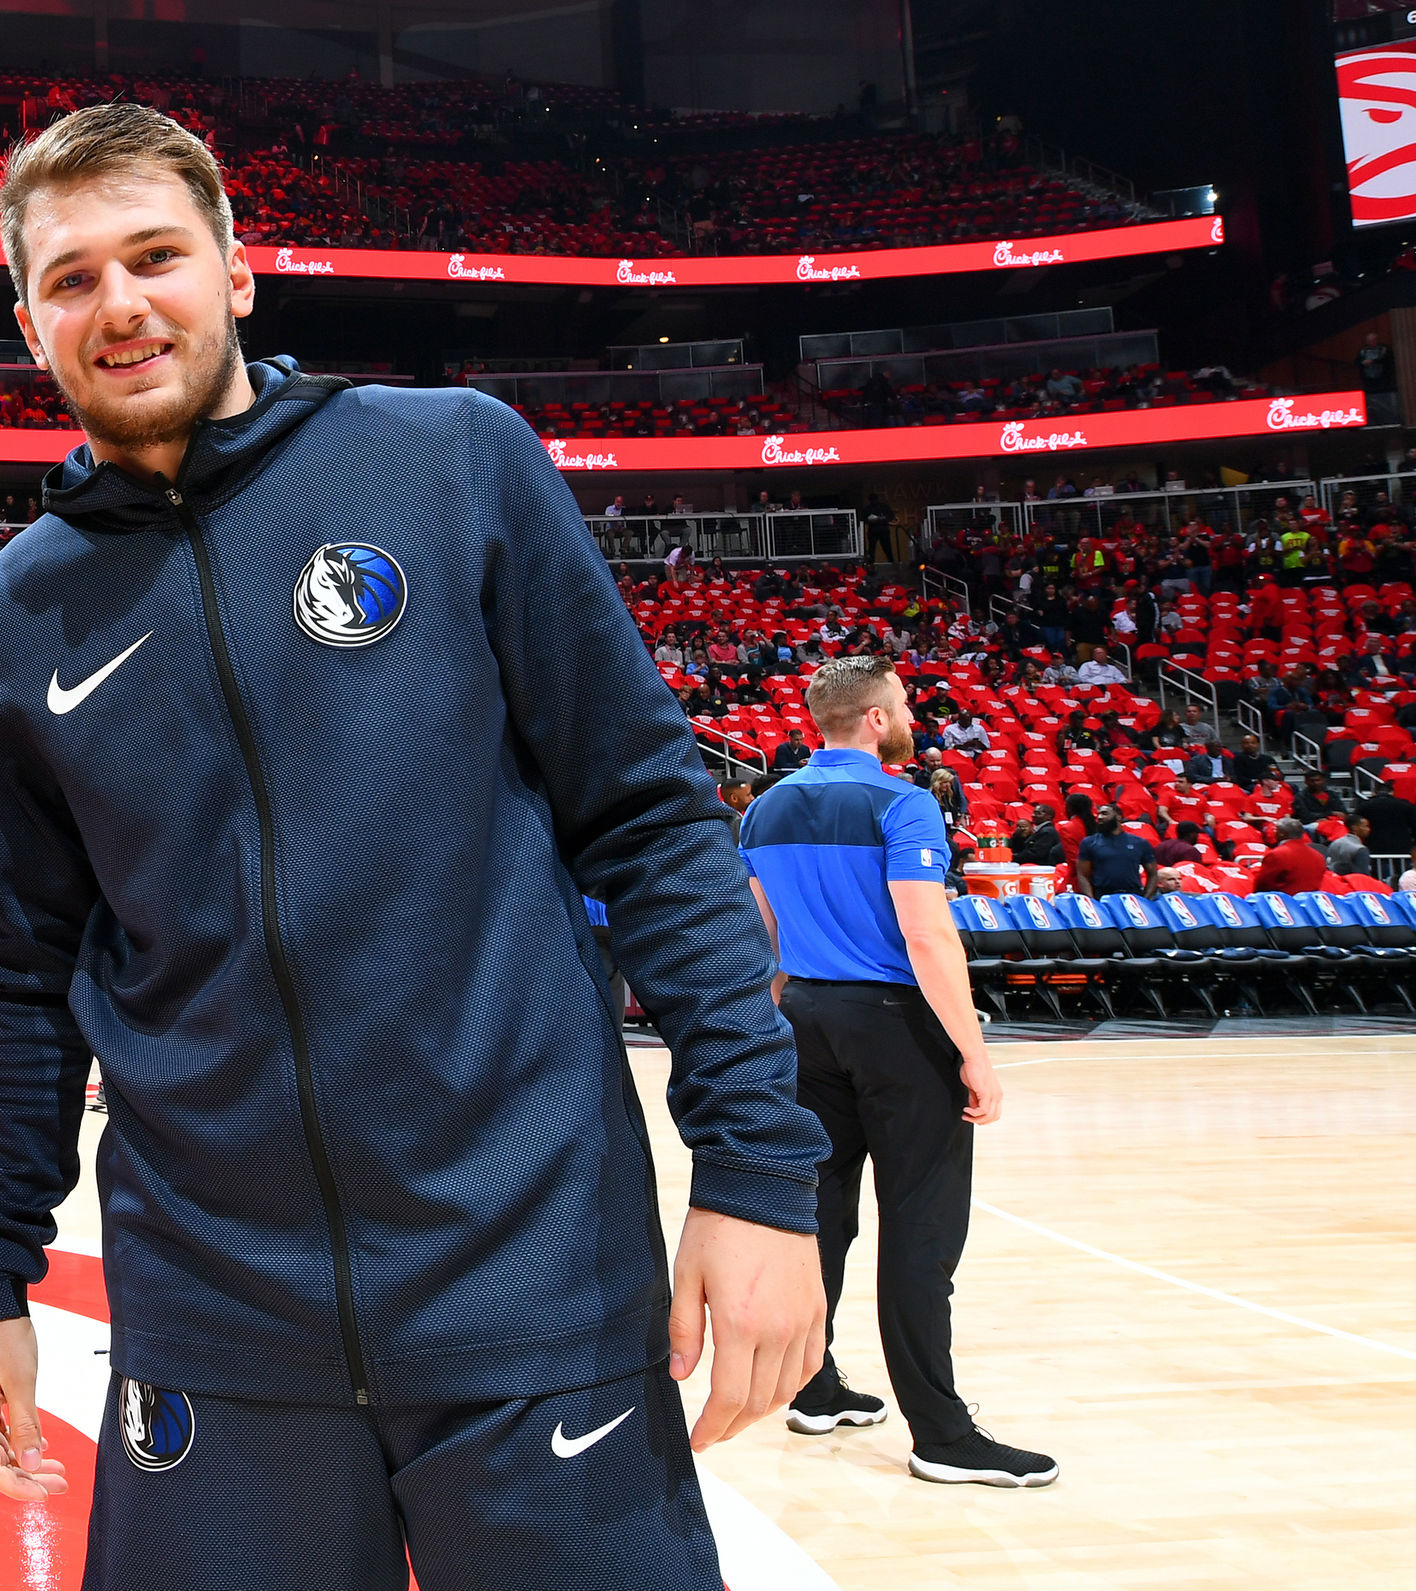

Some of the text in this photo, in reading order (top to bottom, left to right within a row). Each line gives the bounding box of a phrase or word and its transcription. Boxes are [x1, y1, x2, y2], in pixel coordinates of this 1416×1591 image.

[276, 248, 334, 274] Chick-fil-A
[993, 241, 1063, 266] Chick-fil-A
[448, 254, 504, 280] Chick-fil-A
[617, 260, 676, 285] Chick-fil-A
[797, 256, 860, 280] Chick-fil-A
[1267, 398, 1364, 429] Chick-fil-A
[762, 435, 840, 464] Chick-fil-A
[1001, 422, 1087, 451] Chick-fil-A
[1005, 882, 1016, 895] G
